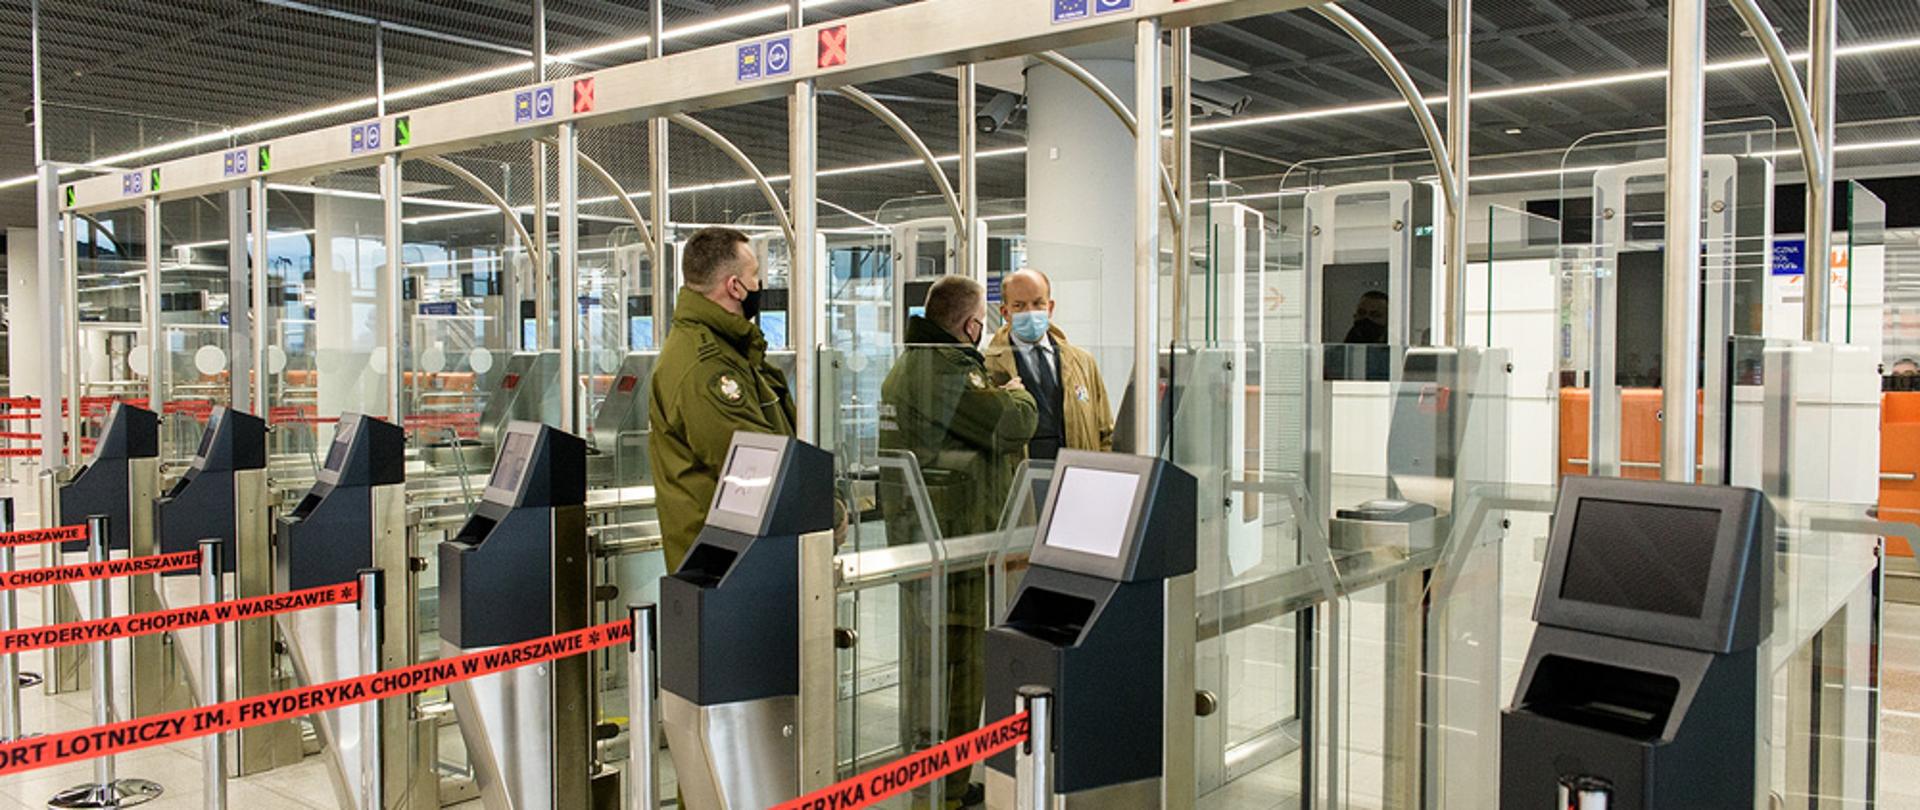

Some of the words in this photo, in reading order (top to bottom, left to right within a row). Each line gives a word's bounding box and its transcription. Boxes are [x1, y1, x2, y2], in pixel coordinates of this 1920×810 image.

[9, 567, 84, 585] CHOPINA
[89, 565, 104, 577] W
[108, 553, 200, 573] WARSZAWIE
[5, 622, 121, 649] FRYDERYKA
[127, 608, 209, 633] CHOPINA
[215, 607, 232, 618] W
[237, 590, 335, 613] WARSZAWIE
[56, 716, 186, 758] LOTNICZY
[194, 709, 231, 732] IM.
[239, 683, 365, 721] FRYDERYKA
[370, 663, 456, 694] CHOPINA
[462, 659, 480, 674] W
[484, 636, 582, 669] WARSZAWIE
[870, 753, 951, 797] CHOPINA
[955, 740, 970, 762] W
